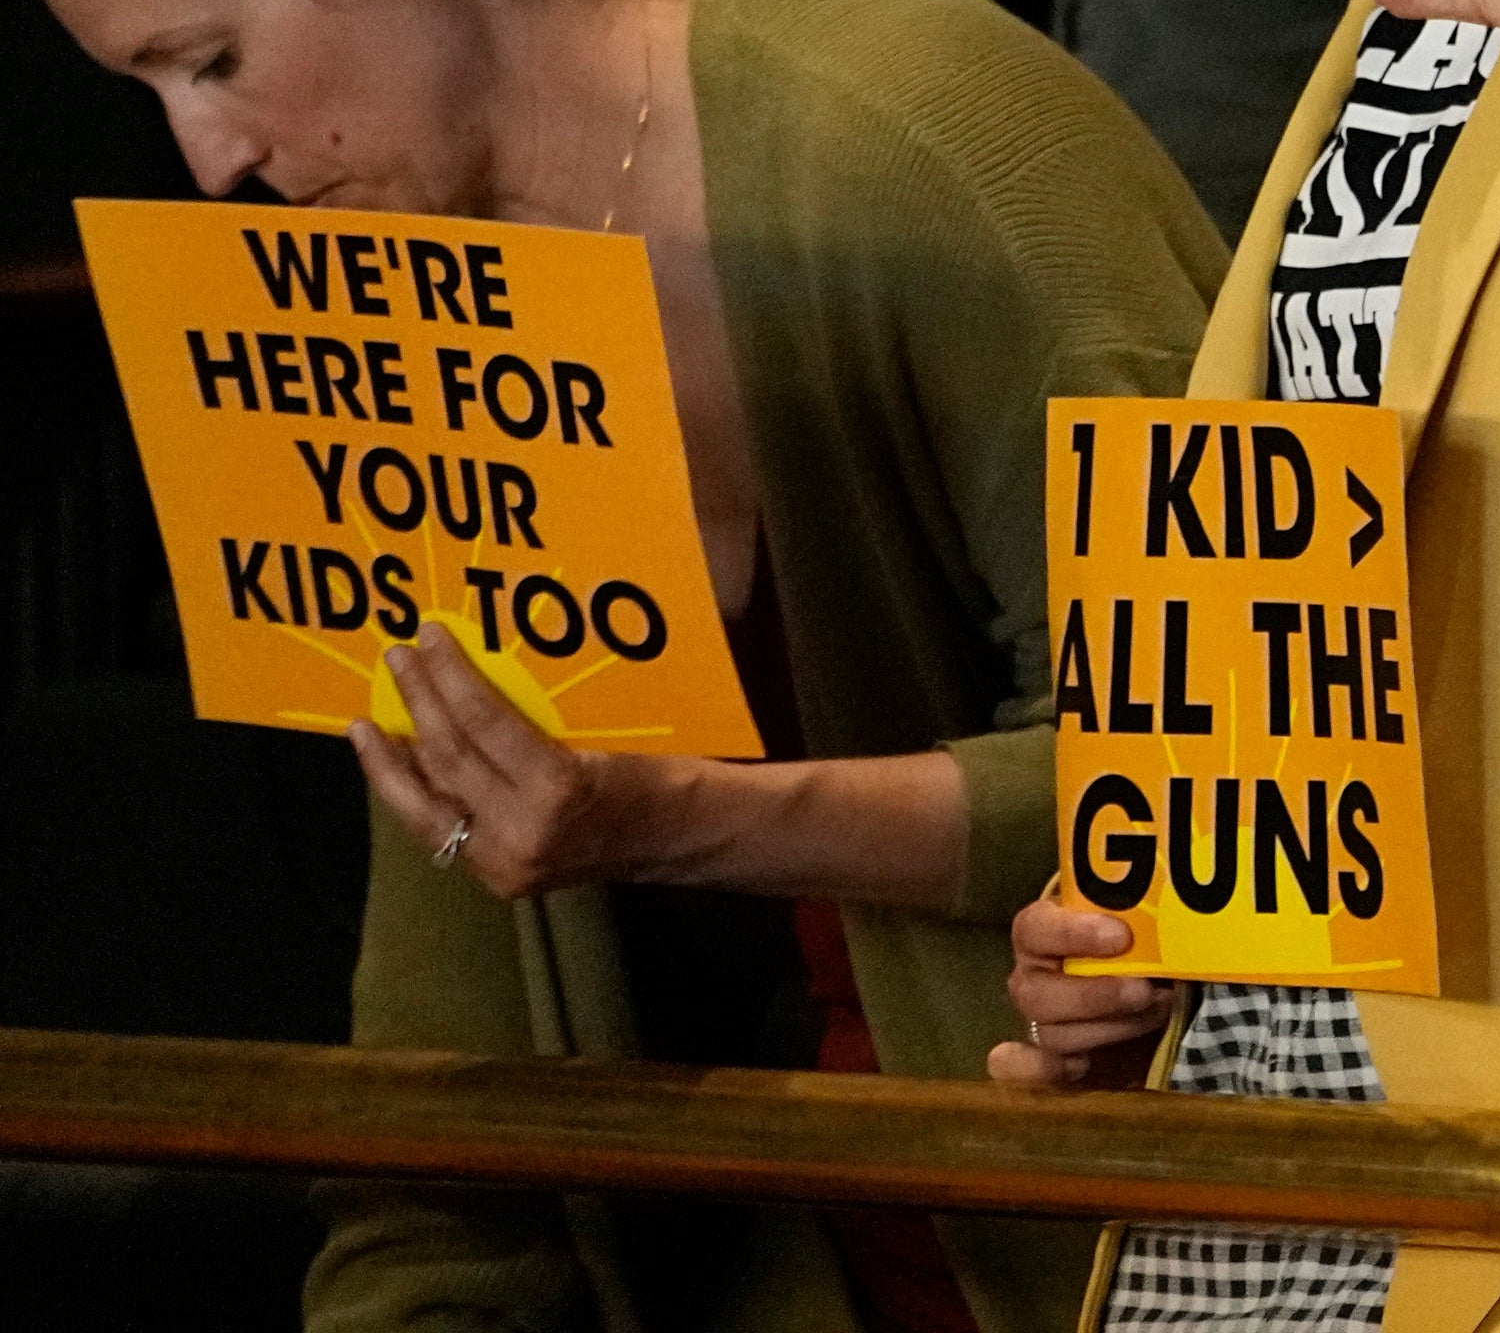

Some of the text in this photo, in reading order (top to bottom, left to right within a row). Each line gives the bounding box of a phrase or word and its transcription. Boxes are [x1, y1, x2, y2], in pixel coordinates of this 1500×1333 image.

[242, 228, 514, 330] WE'RE
[185, 331, 614, 447] HERE FOR
[294, 439, 546, 550] YOUR
[1071, 423, 1096, 557] 1
[1145, 424, 1315, 560] KID
[220, 537, 668, 663] KIDS TOO
[1056, 599, 1405, 745] ALL THE
[1072, 773, 1384, 921] GUNS
